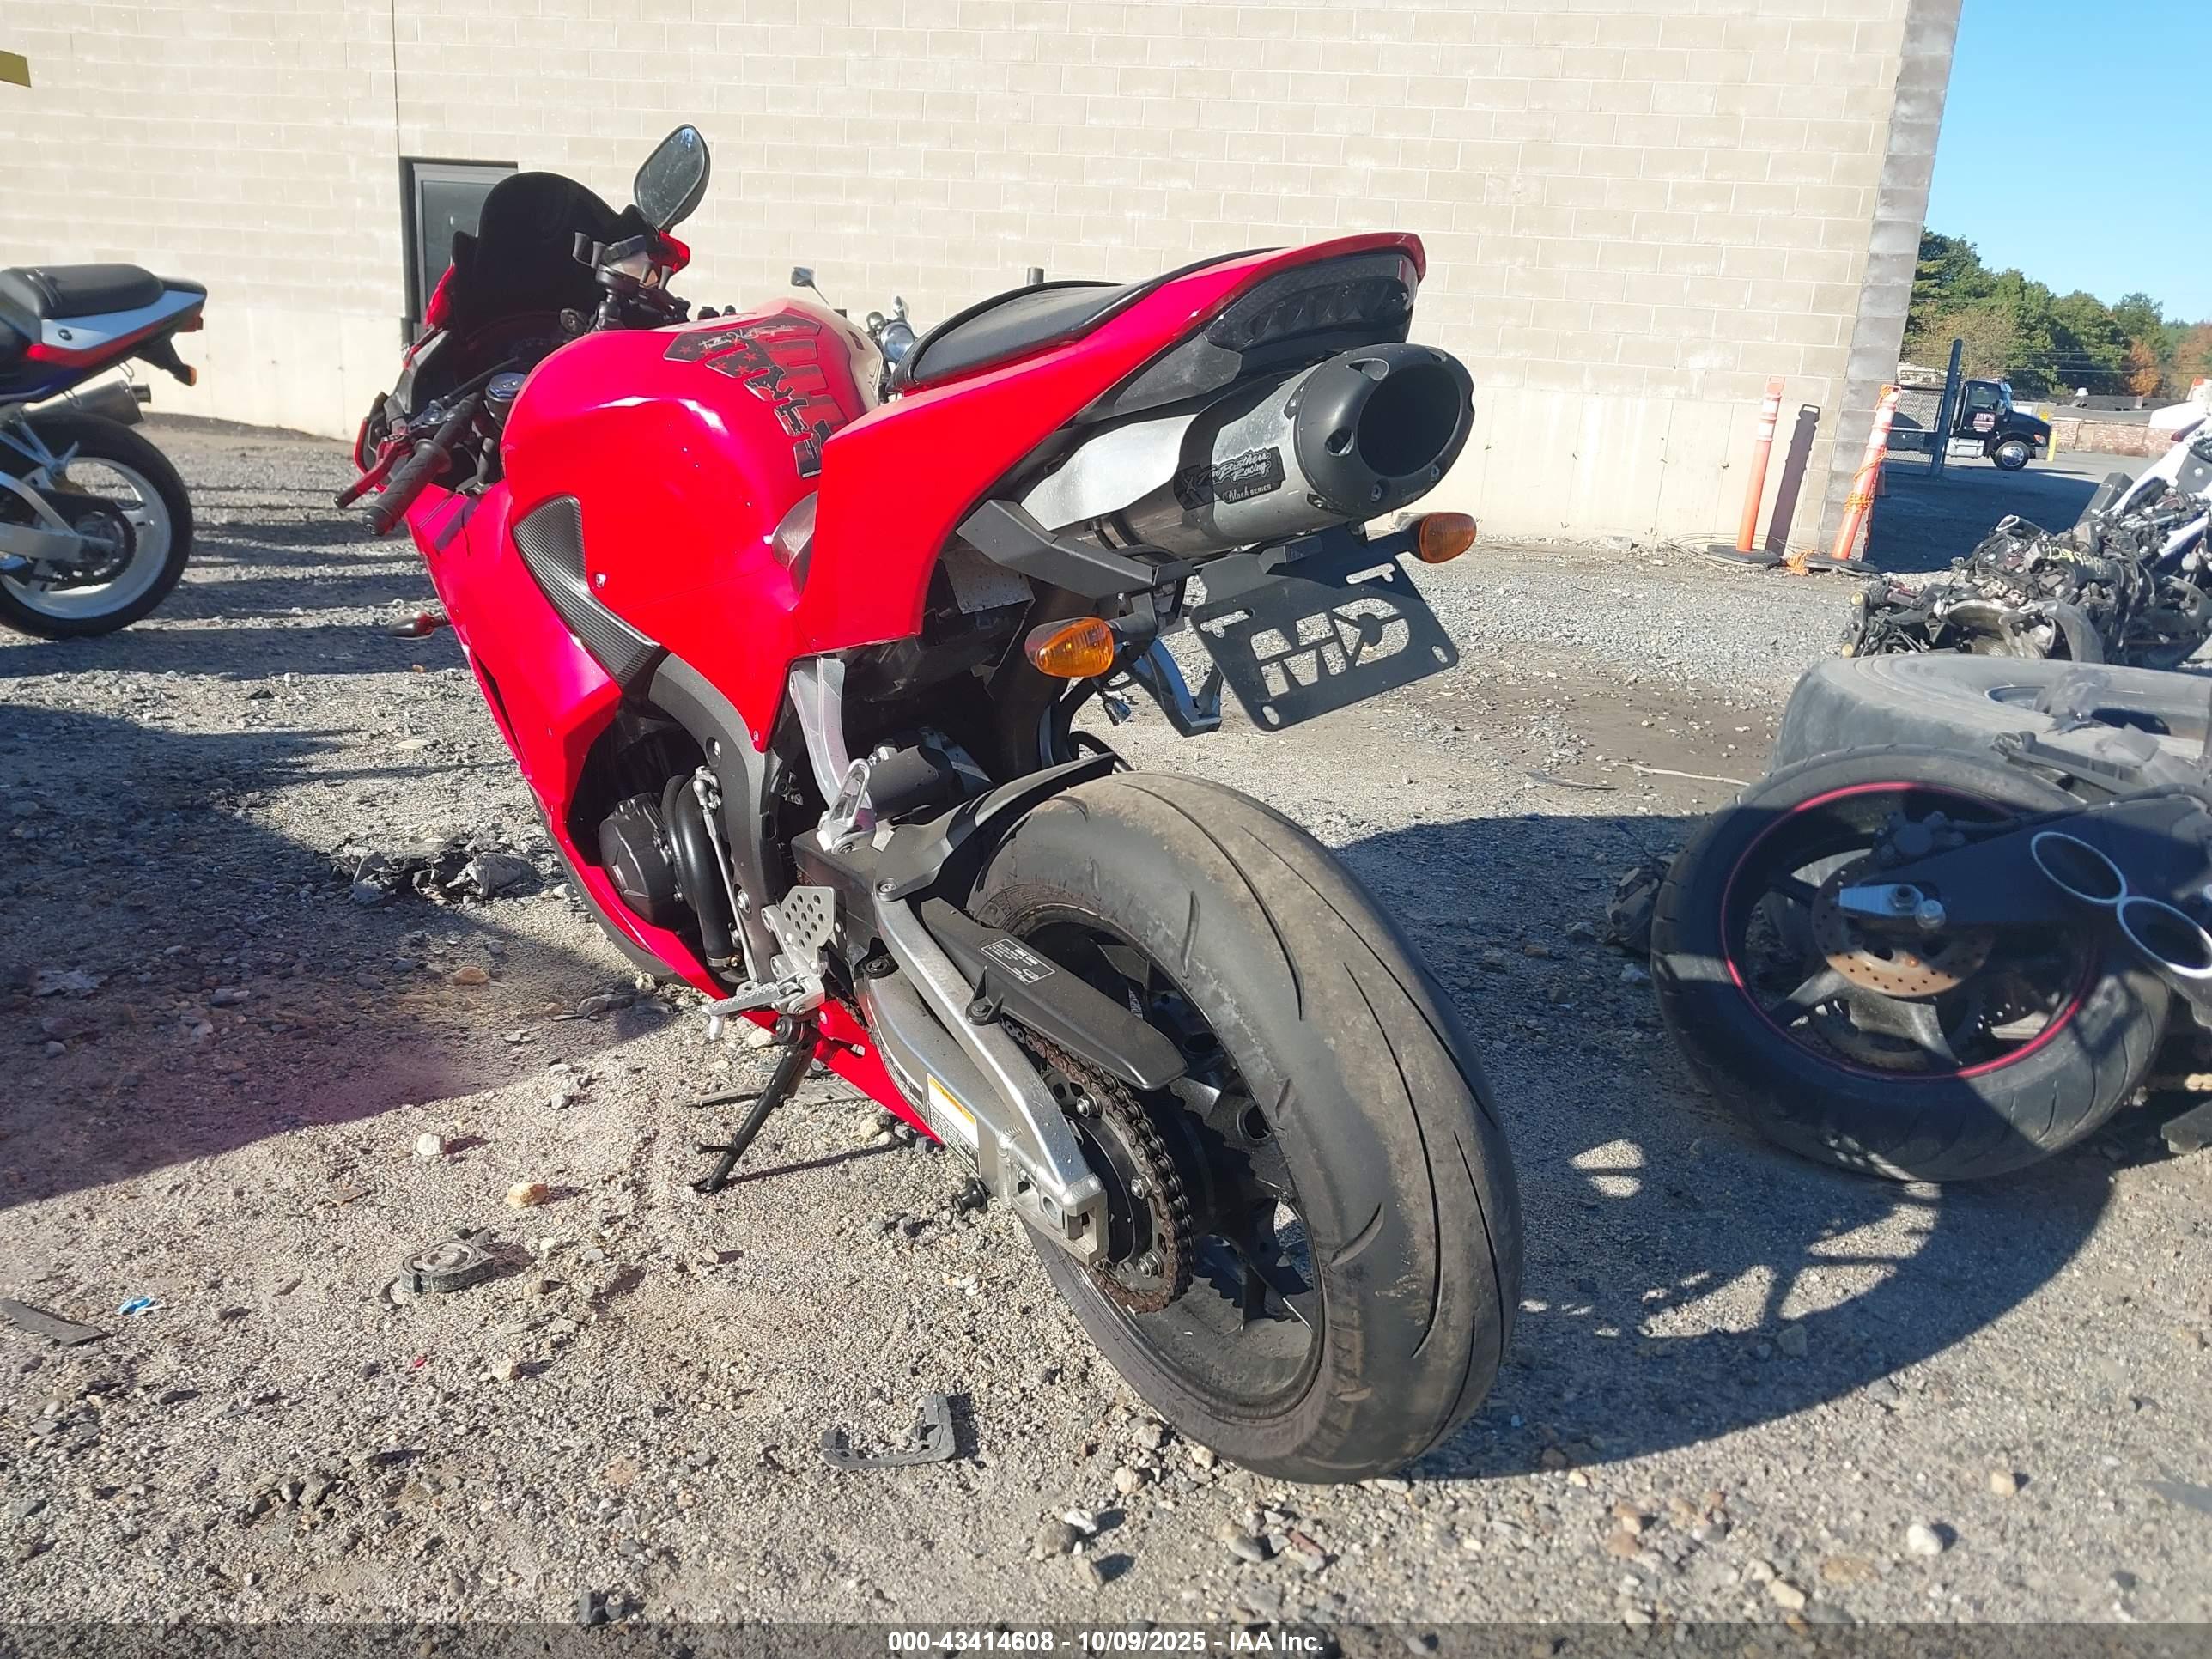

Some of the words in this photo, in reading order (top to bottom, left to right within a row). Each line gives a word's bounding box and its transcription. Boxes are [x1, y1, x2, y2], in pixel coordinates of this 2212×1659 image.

[1218, 451, 1269, 482] Brothers
[1230, 461, 1268, 483] Racing
[1223, 485, 1249, 502] Black
